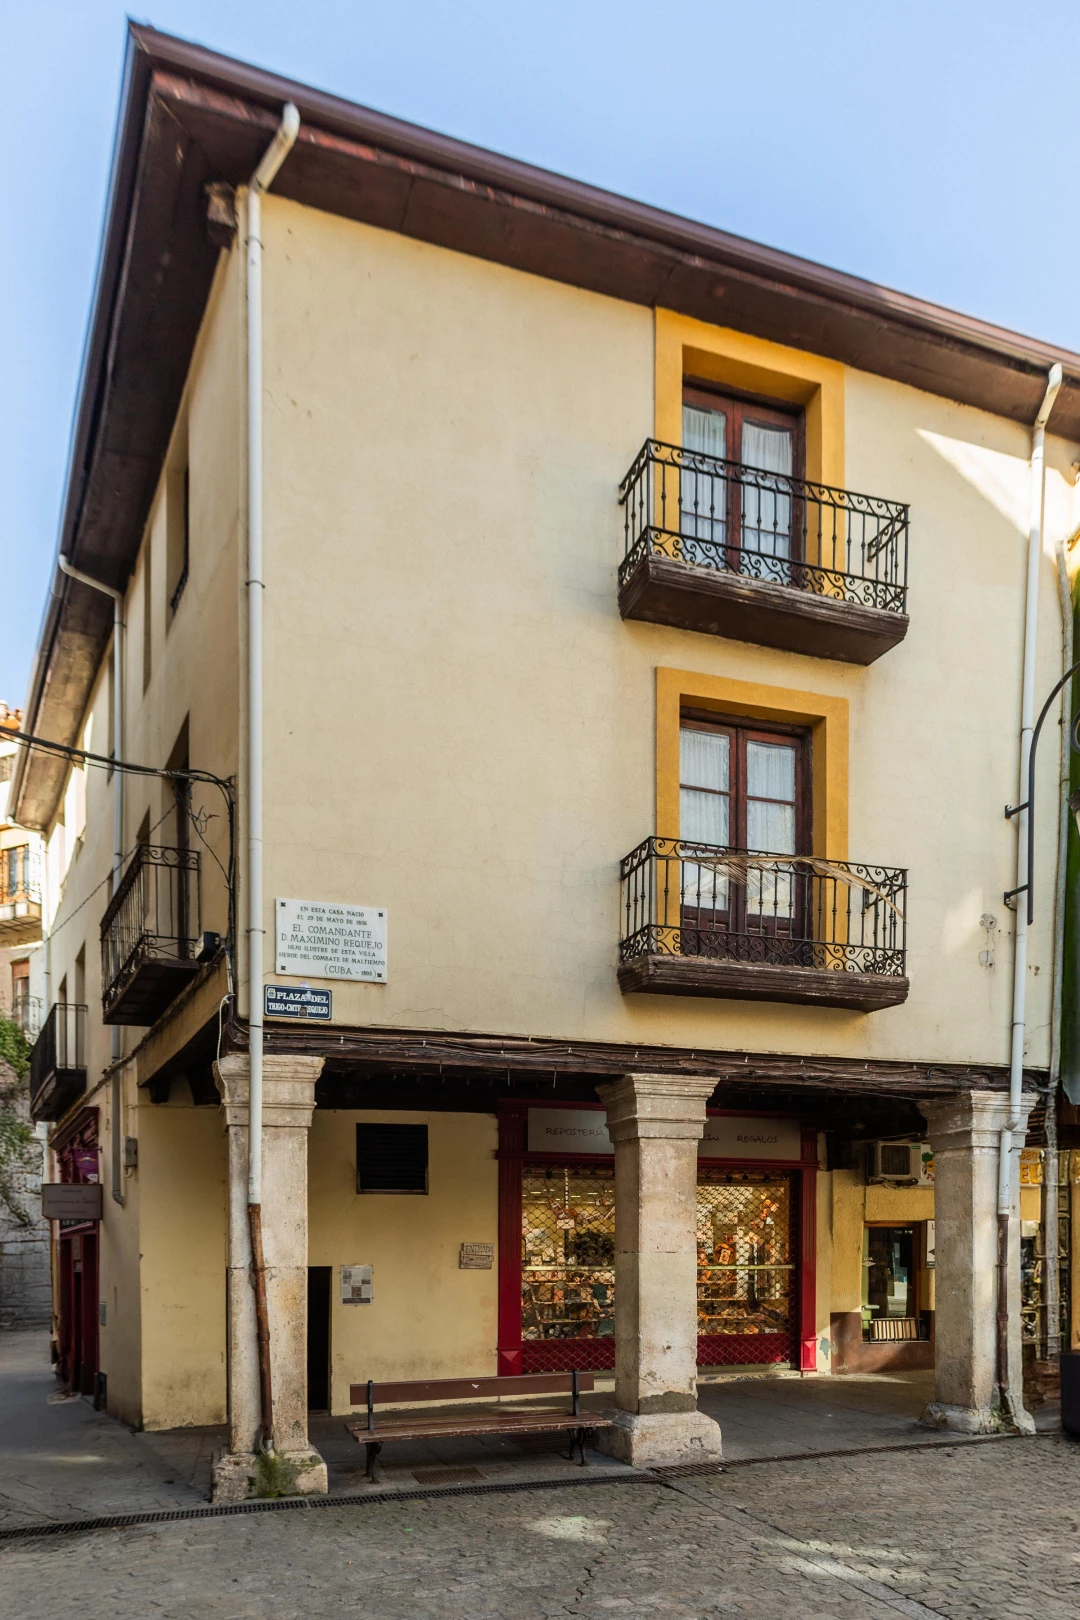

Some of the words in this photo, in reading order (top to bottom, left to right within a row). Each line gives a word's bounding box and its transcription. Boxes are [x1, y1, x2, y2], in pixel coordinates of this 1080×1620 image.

[292, 924, 304, 933] EL
[308, 925, 372, 939] COMANDANTE
[290, 934, 340, 946] MAXIMINO
[343, 939, 382, 950] REQUEJO
[304, 945, 329, 953] ILUSTRE
[341, 948, 356, 956] ESTA
[312, 954, 340, 963] COMBATE
[351, 958, 385, 966] MALTIEMPO
[276, 991, 306, 1002] PLAZA
[311, 995, 328, 1004] DEL
[304, 1005, 328, 1014] EQUEJO
[736, 1134, 778, 1144] REGALOS
